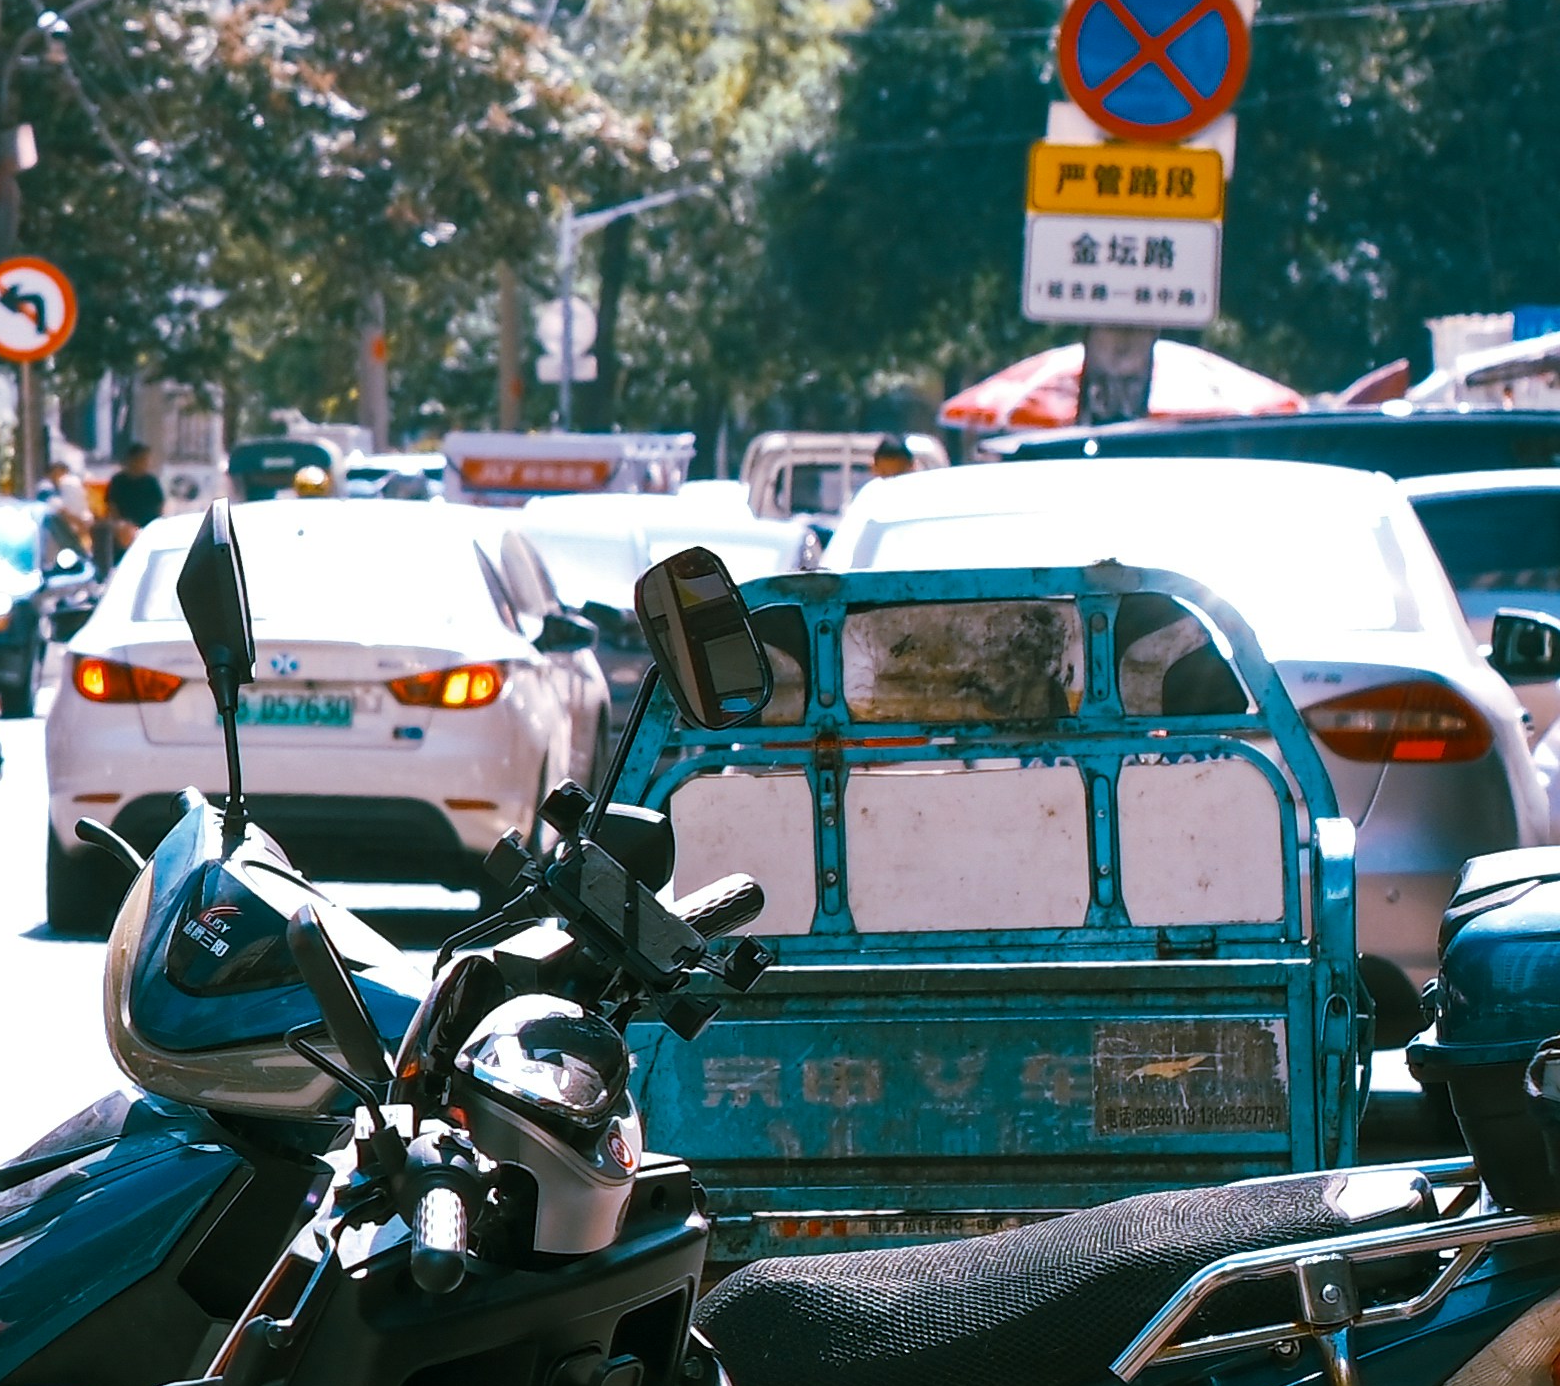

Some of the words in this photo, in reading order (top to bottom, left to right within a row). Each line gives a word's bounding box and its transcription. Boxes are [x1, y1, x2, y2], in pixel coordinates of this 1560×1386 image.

[1056, 162, 1197, 199] 严管路段
[1070, 233, 1175, 269] 金坛路
